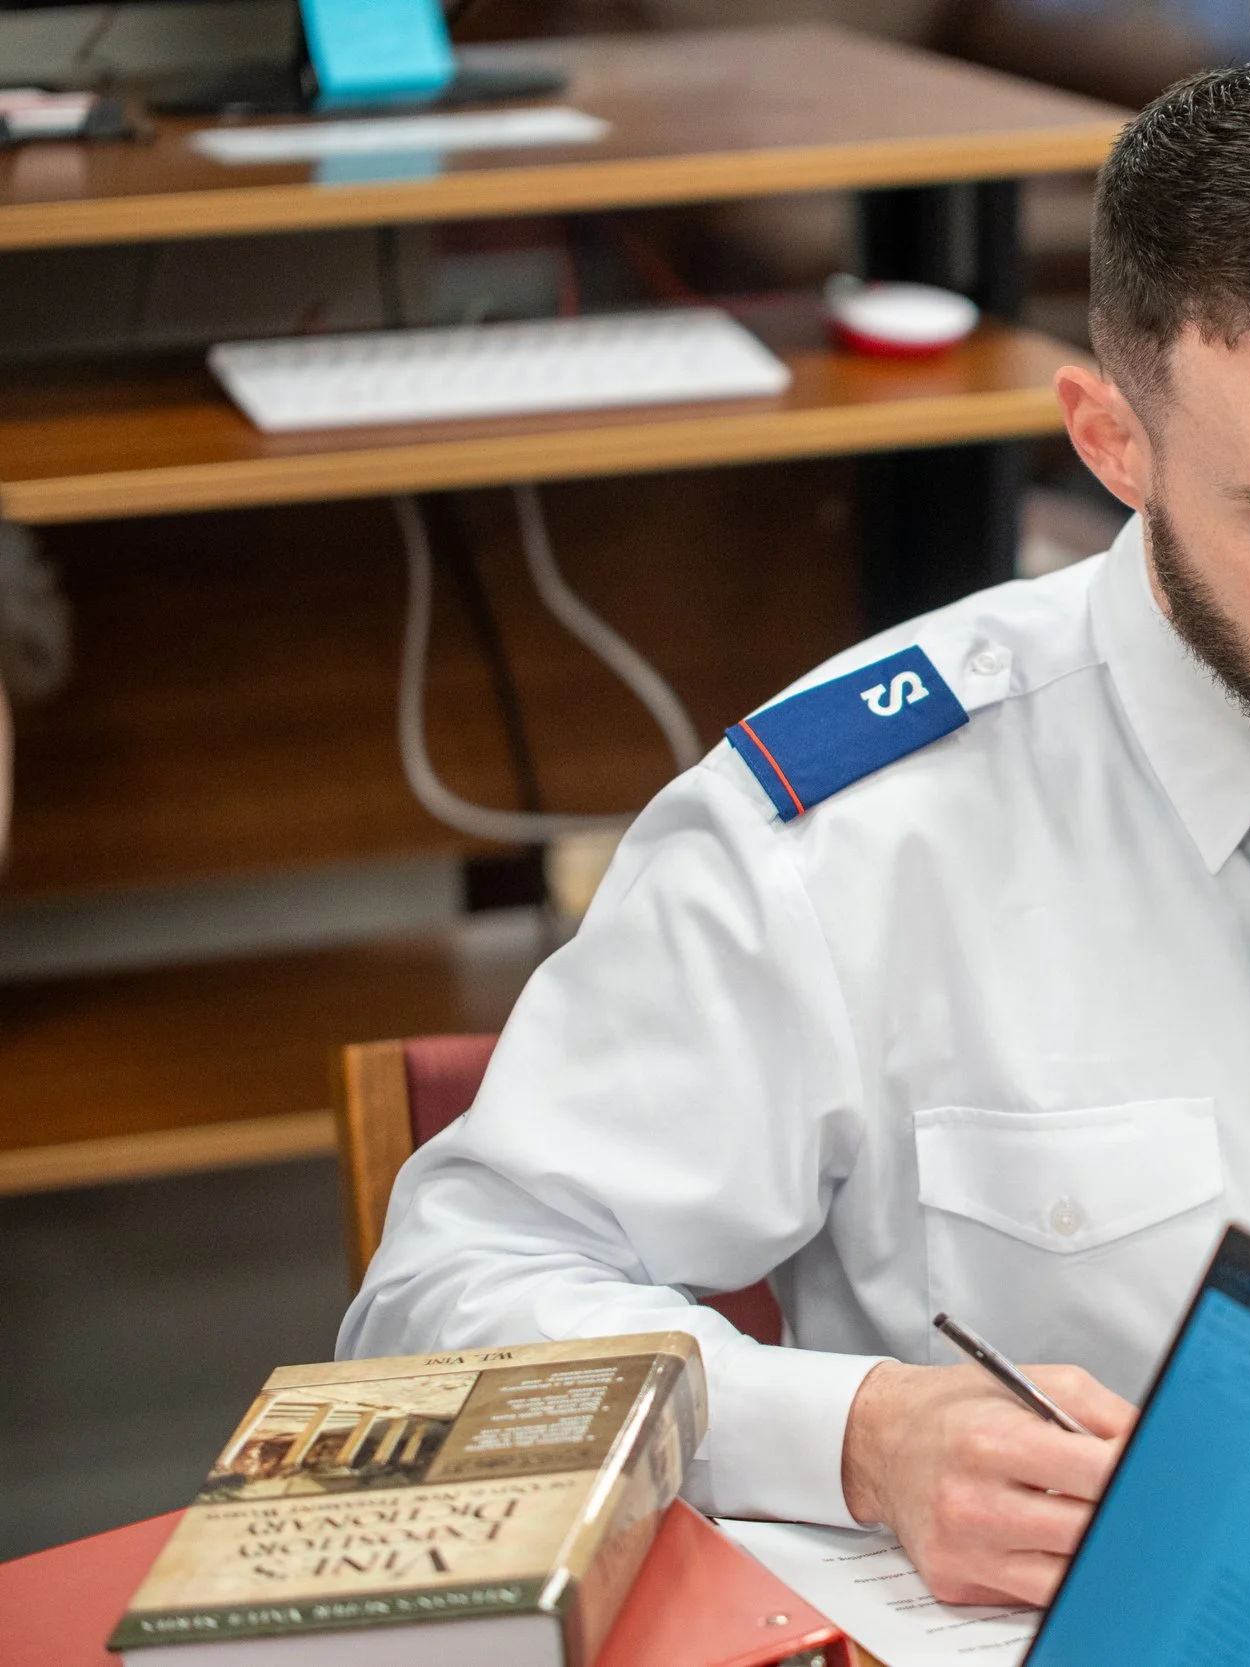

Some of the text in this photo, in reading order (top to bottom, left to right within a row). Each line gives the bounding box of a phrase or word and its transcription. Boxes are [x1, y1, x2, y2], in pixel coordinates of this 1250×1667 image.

[860, 670, 930, 717] S
[423, 1356, 465, 1366] VINE
[246, 1498, 519, 1537] DICTIONARY
[237, 1520, 502, 1560] EXPOSITORY
